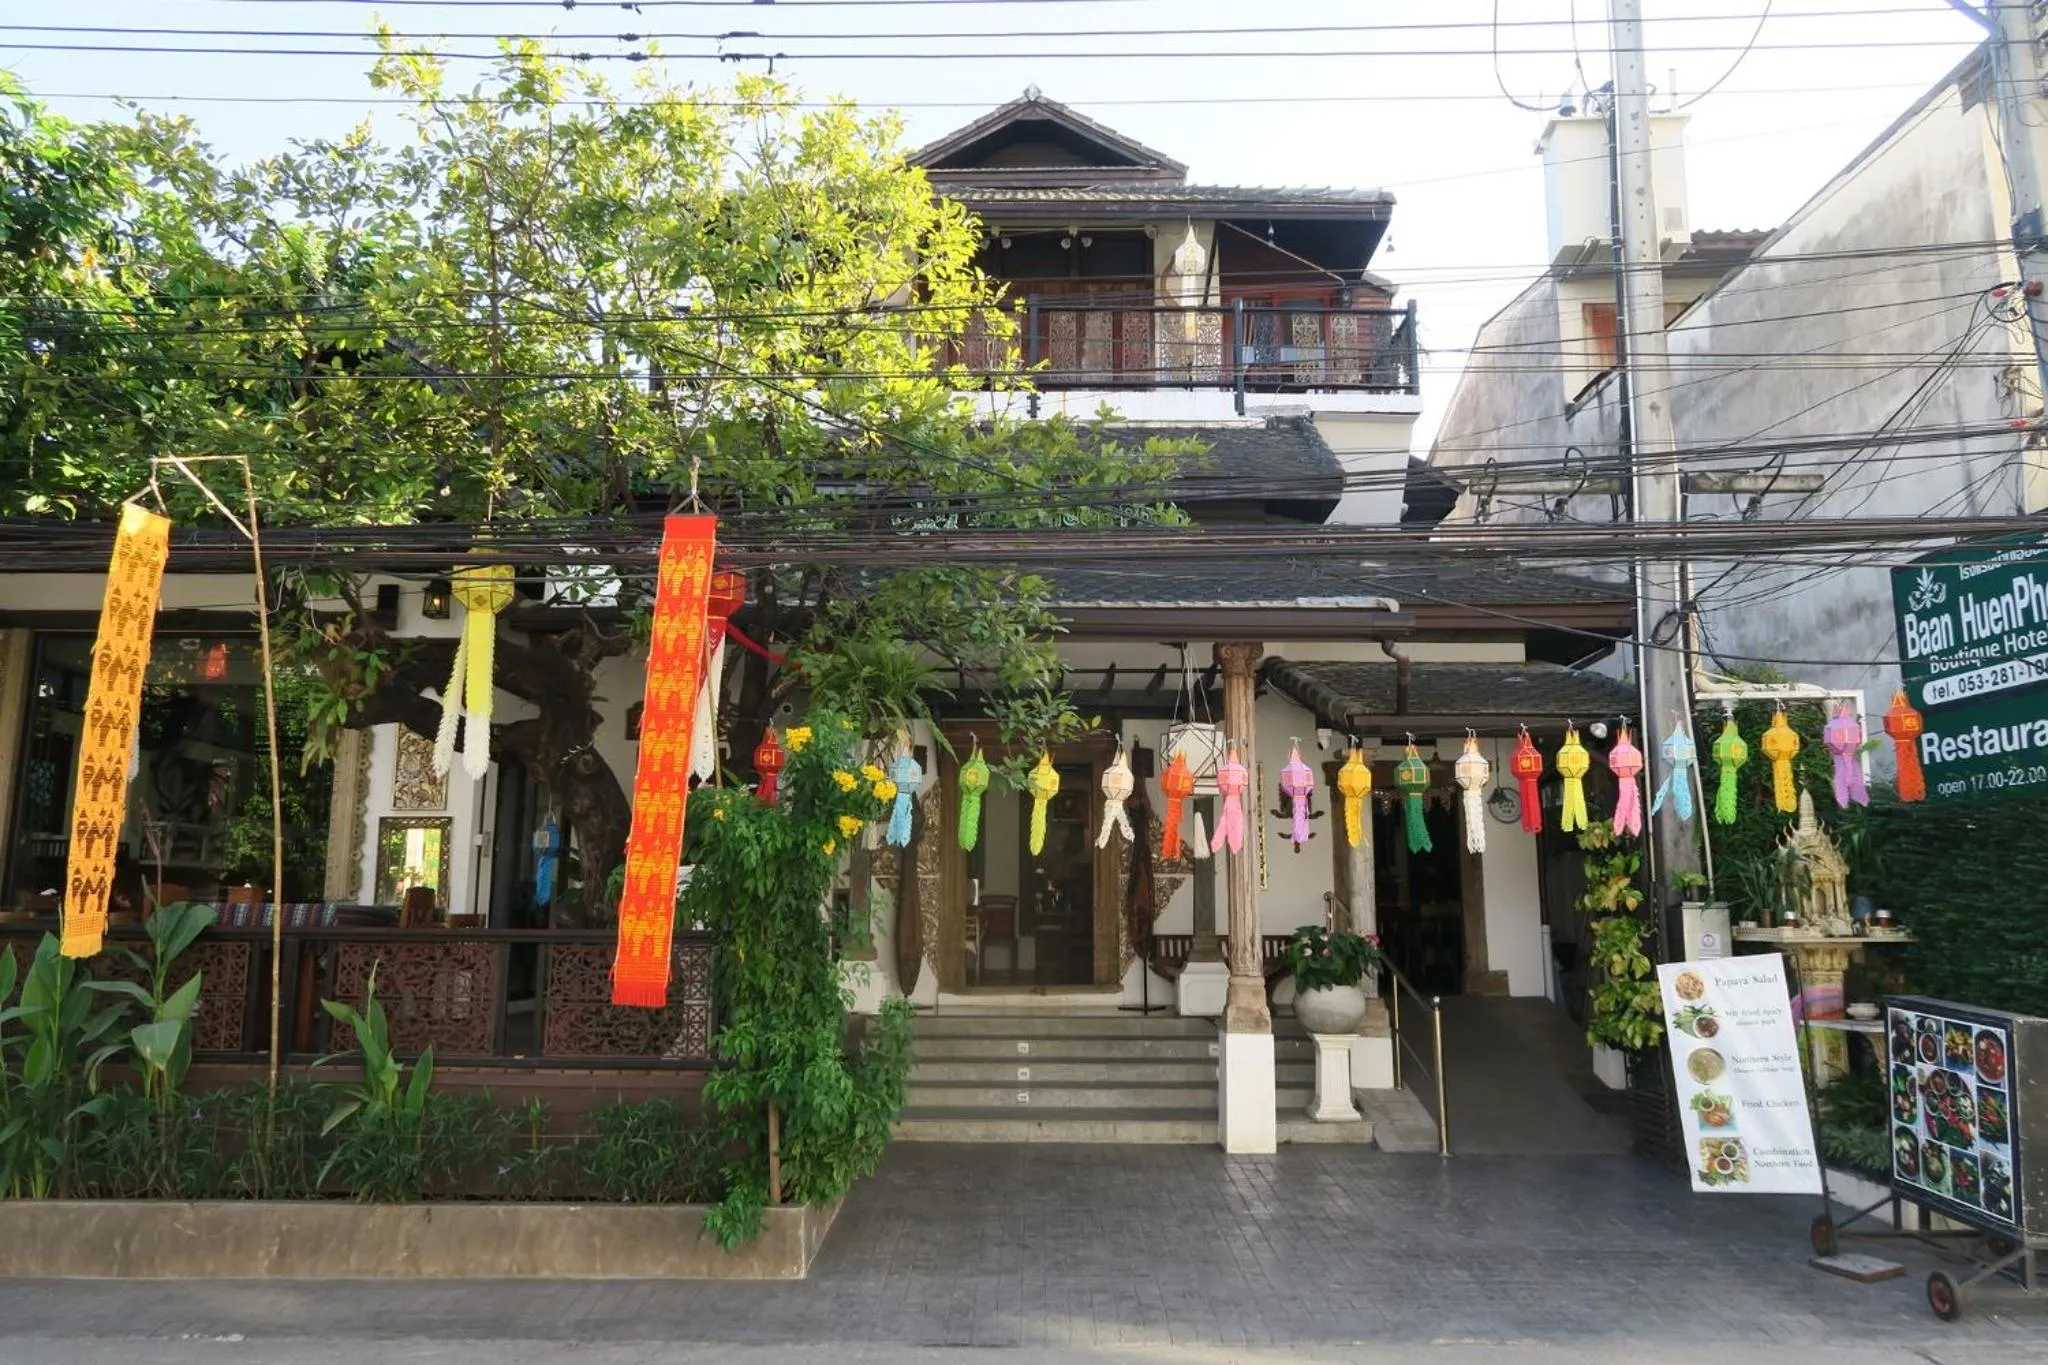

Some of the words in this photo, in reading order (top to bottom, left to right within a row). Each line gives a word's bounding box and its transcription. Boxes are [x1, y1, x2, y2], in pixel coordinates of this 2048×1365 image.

[1903, 612, 1954, 659] Baan
[1959, 573, 2048, 643] HuenPh
[1929, 642, 2001, 674] Boutique
[1932, 682, 1955, 700] tel.
[1921, 718, 2048, 765] Restaura
[1937, 780, 1967, 798] open
